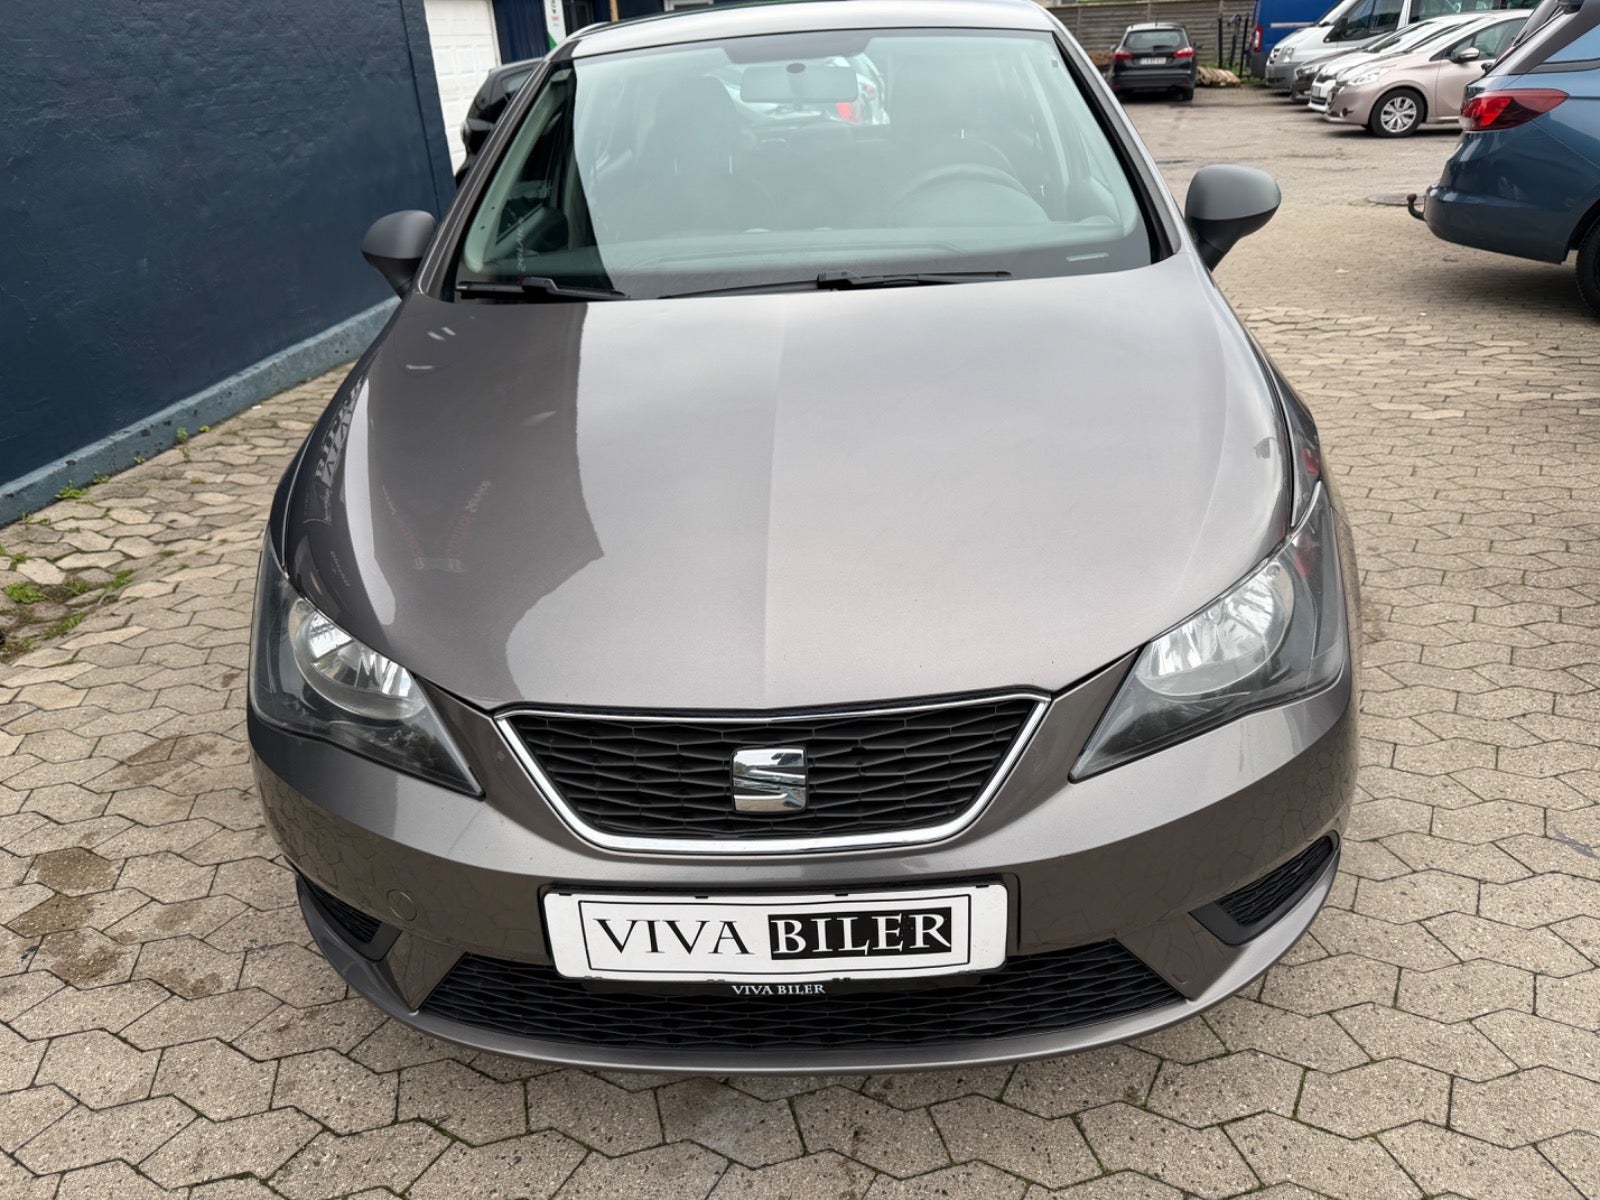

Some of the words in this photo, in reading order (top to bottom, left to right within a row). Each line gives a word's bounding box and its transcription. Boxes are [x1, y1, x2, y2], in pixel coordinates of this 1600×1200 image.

[593, 918, 755, 955] VIVA
[770, 913, 951, 955] BILER
[731, 985, 773, 995] VIVA
[776, 984, 826, 995] BILER
